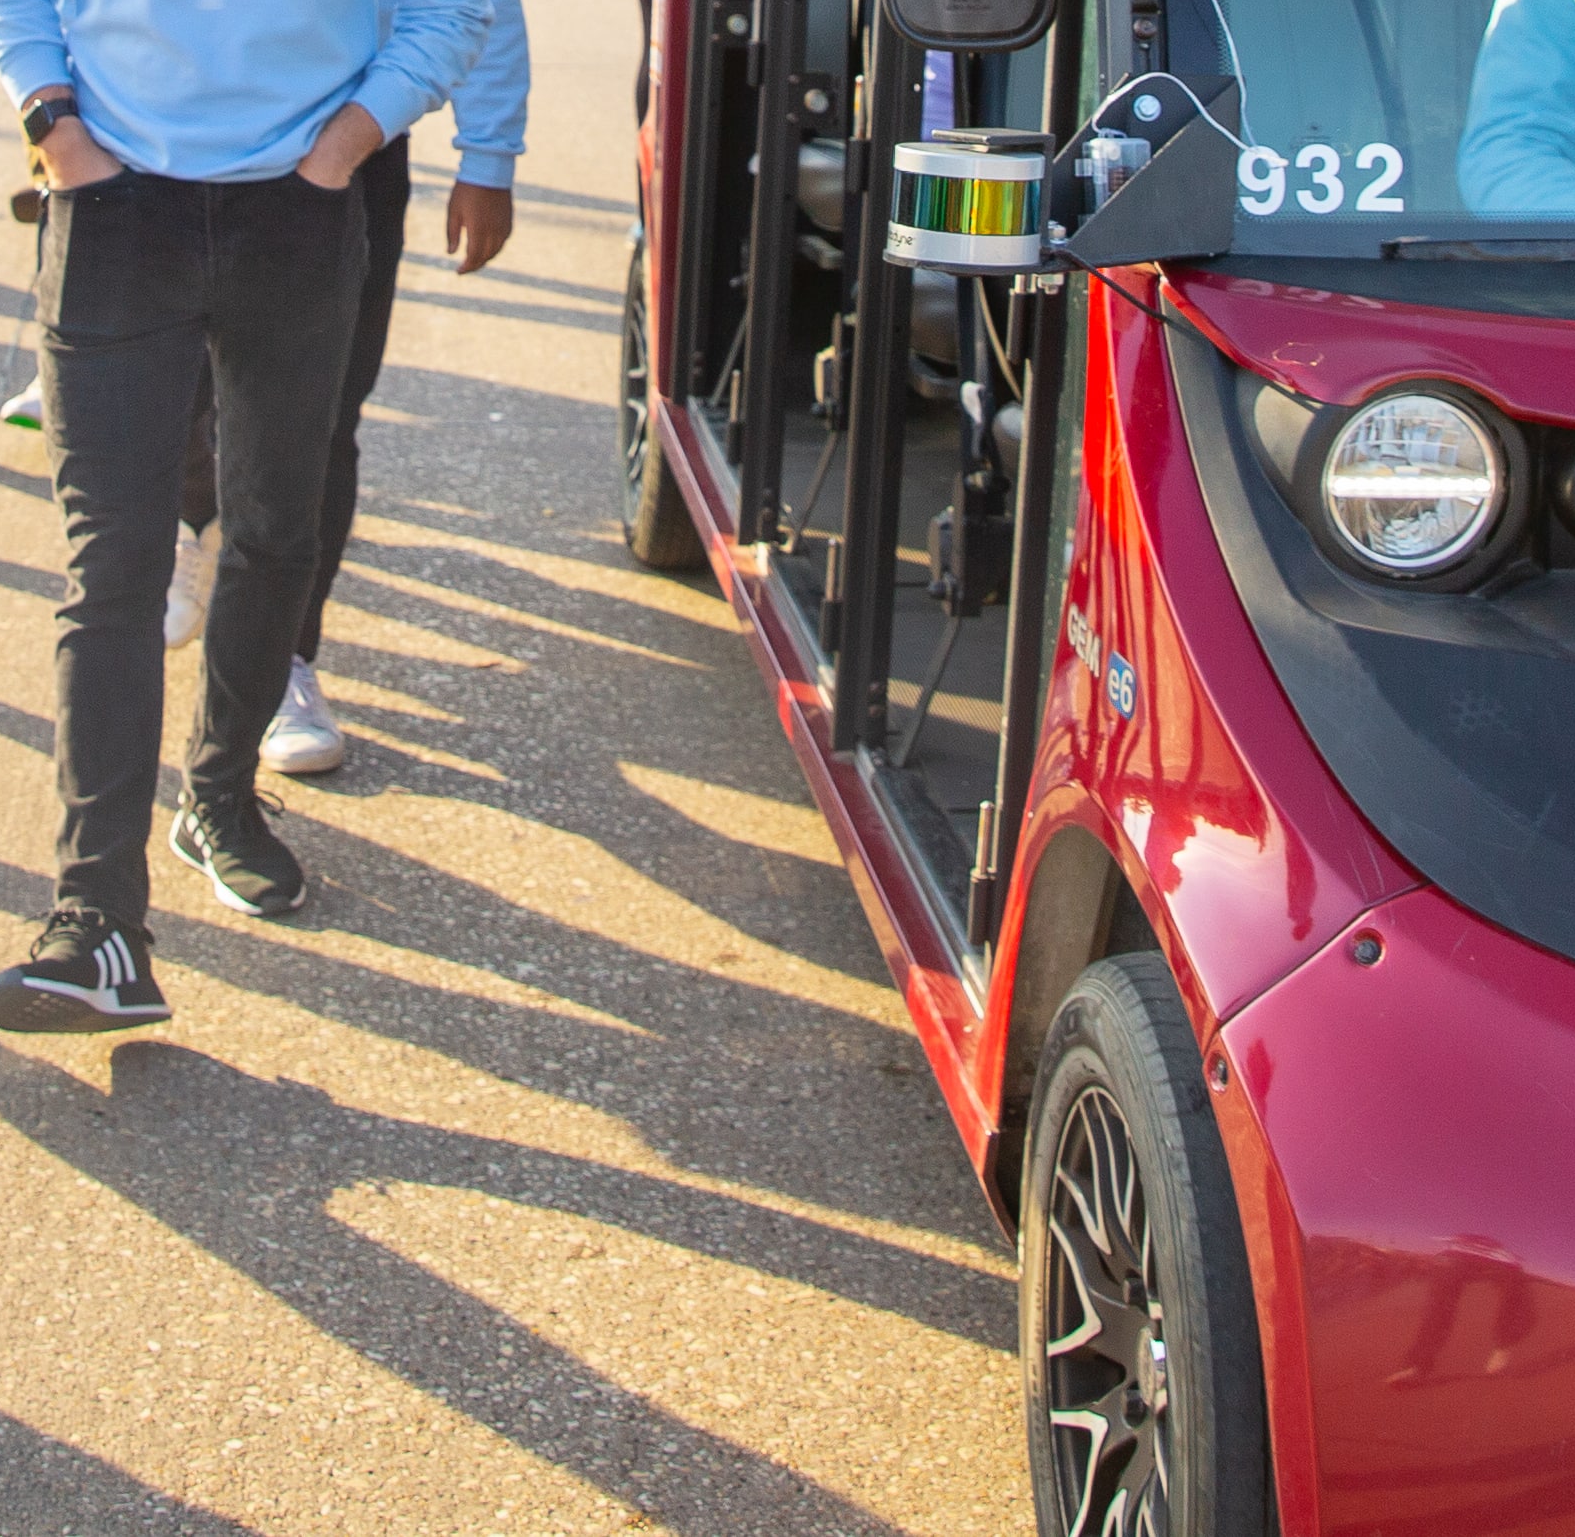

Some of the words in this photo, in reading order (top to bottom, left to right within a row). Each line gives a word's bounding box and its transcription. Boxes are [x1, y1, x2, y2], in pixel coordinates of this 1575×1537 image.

[1237, 142, 1405, 216] 932
[1066, 602, 1102, 679] GEM
[1106, 667, 1135, 714] e6
